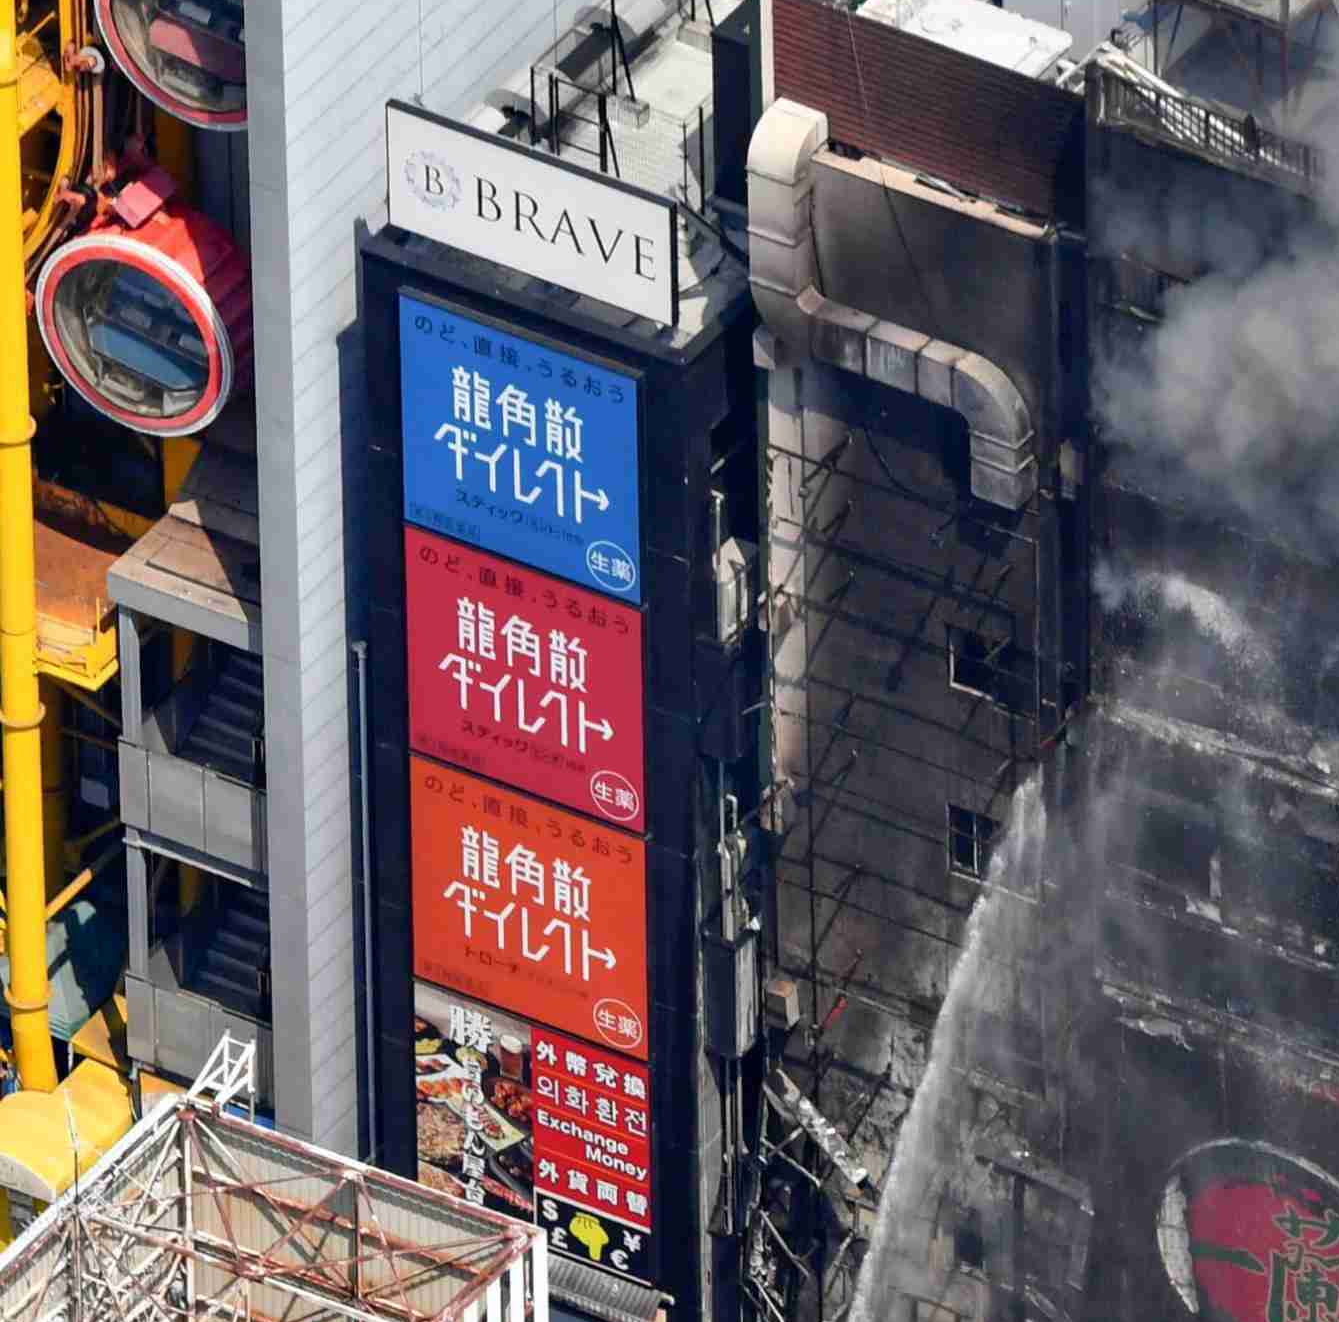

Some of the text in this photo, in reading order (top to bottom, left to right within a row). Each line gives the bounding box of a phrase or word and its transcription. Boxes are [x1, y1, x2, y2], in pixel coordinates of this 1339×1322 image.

[423, 165, 657, 282] B BRAVE
[450, 365, 585, 464] 龍角散
[456, 596, 588, 693] 龍角散
[460, 825, 593, 923] 龍角散
[537, 1075, 649, 1138] 외화환전
[537, 1109, 630, 1157] Exchange
[585, 1143, 649, 1182] Money
